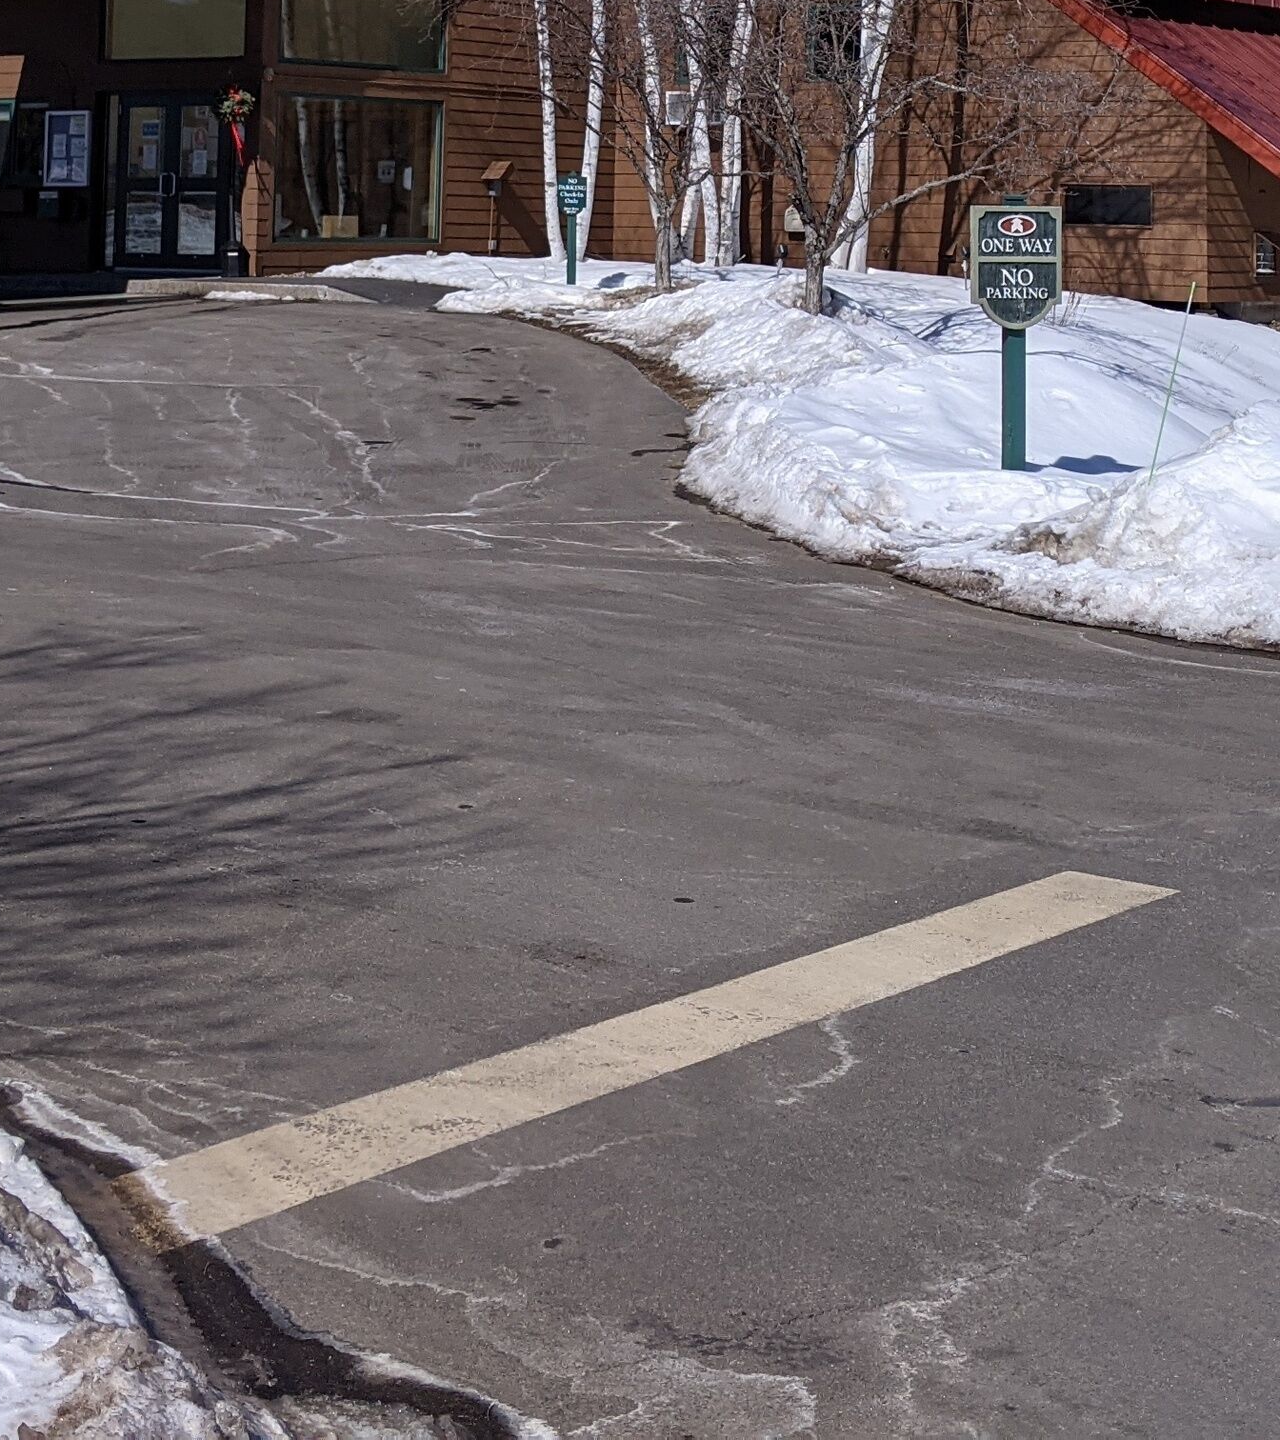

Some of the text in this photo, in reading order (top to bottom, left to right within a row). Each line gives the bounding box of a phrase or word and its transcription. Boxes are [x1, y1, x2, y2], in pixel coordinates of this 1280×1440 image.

[981, 238, 1053, 253] ONE WAY
[1001, 268, 1034, 286] NO
[986, 287, 1048, 299] PARKING
